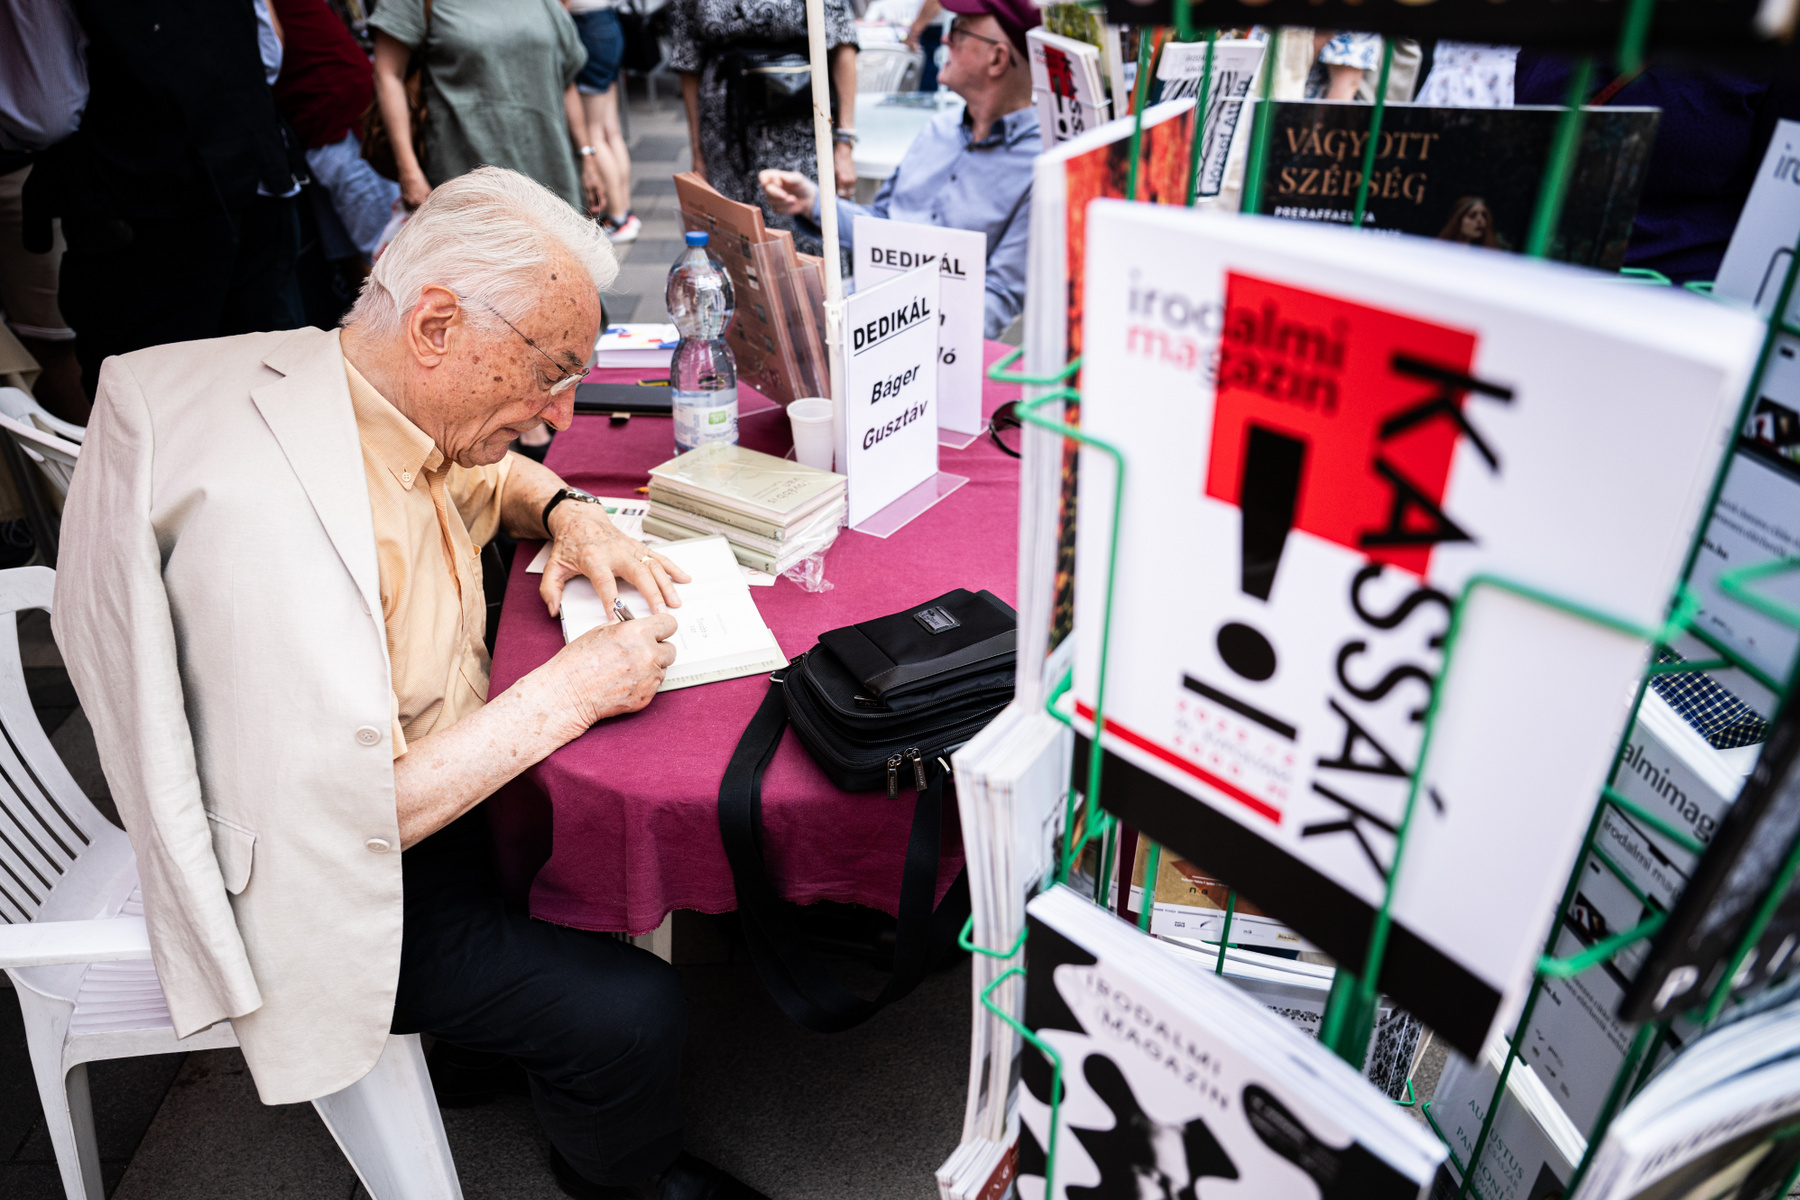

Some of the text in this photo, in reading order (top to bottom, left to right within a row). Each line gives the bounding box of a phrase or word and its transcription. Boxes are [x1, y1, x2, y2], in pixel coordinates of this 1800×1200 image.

[1286, 122, 1439, 162] VÁGYOTT
[1278, 163, 1428, 206] SZÉPSÉG
[853, 296, 931, 351] DEDIKÁL
[1127, 270, 1351, 370] irodalmi
[870, 364, 921, 406] Báger
[1125, 323, 1340, 416] magazin
[862, 400, 928, 451] Gusztáv
[1086, 971, 1222, 1077] IRODALMI
[1099, 1009, 1229, 1110] MAGAZIN
[1468, 1099, 1525, 1180] AUUSTUS
